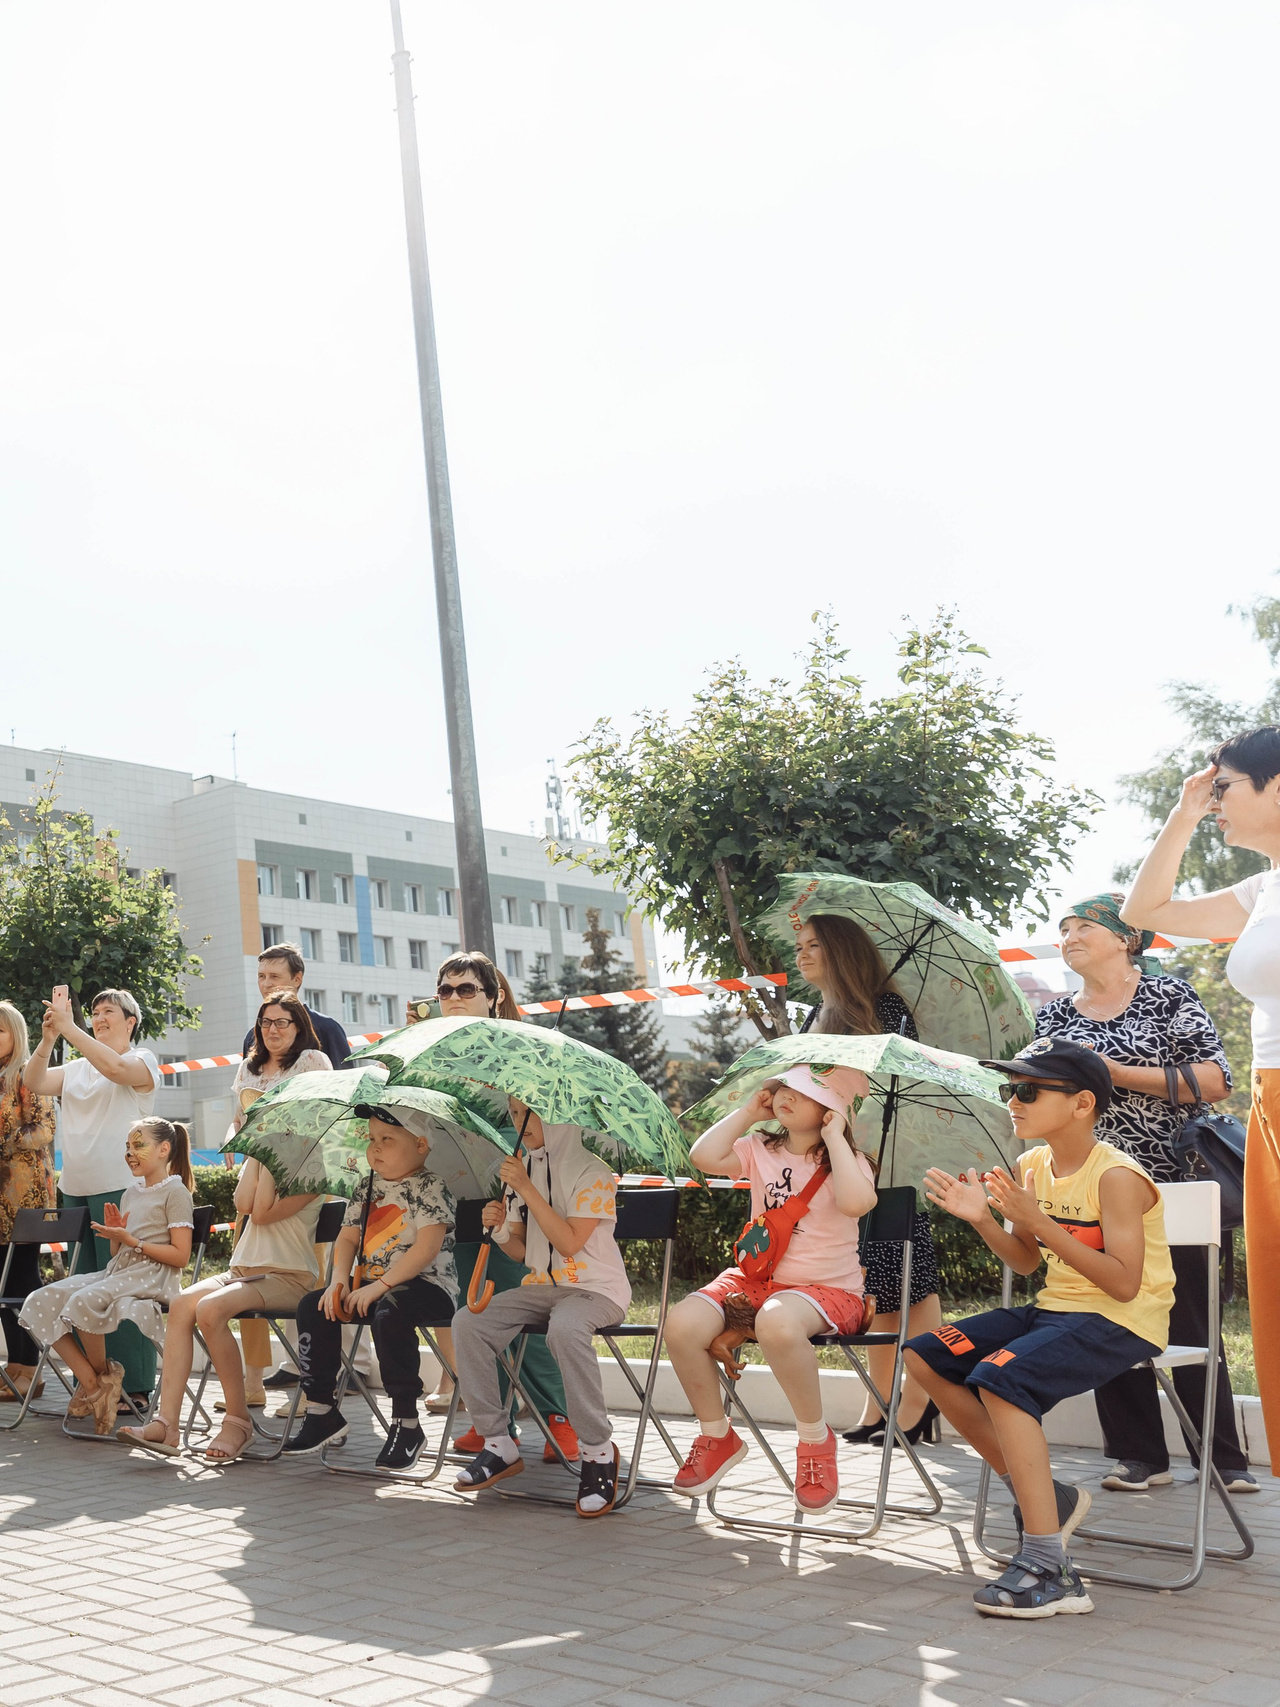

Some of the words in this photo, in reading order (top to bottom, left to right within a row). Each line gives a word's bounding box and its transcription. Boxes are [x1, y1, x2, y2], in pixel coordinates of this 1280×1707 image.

[775, 1167, 793, 1193] Я
[1037, 1199, 1082, 1216] TOMY
[935, 1326, 967, 1347] AIN
